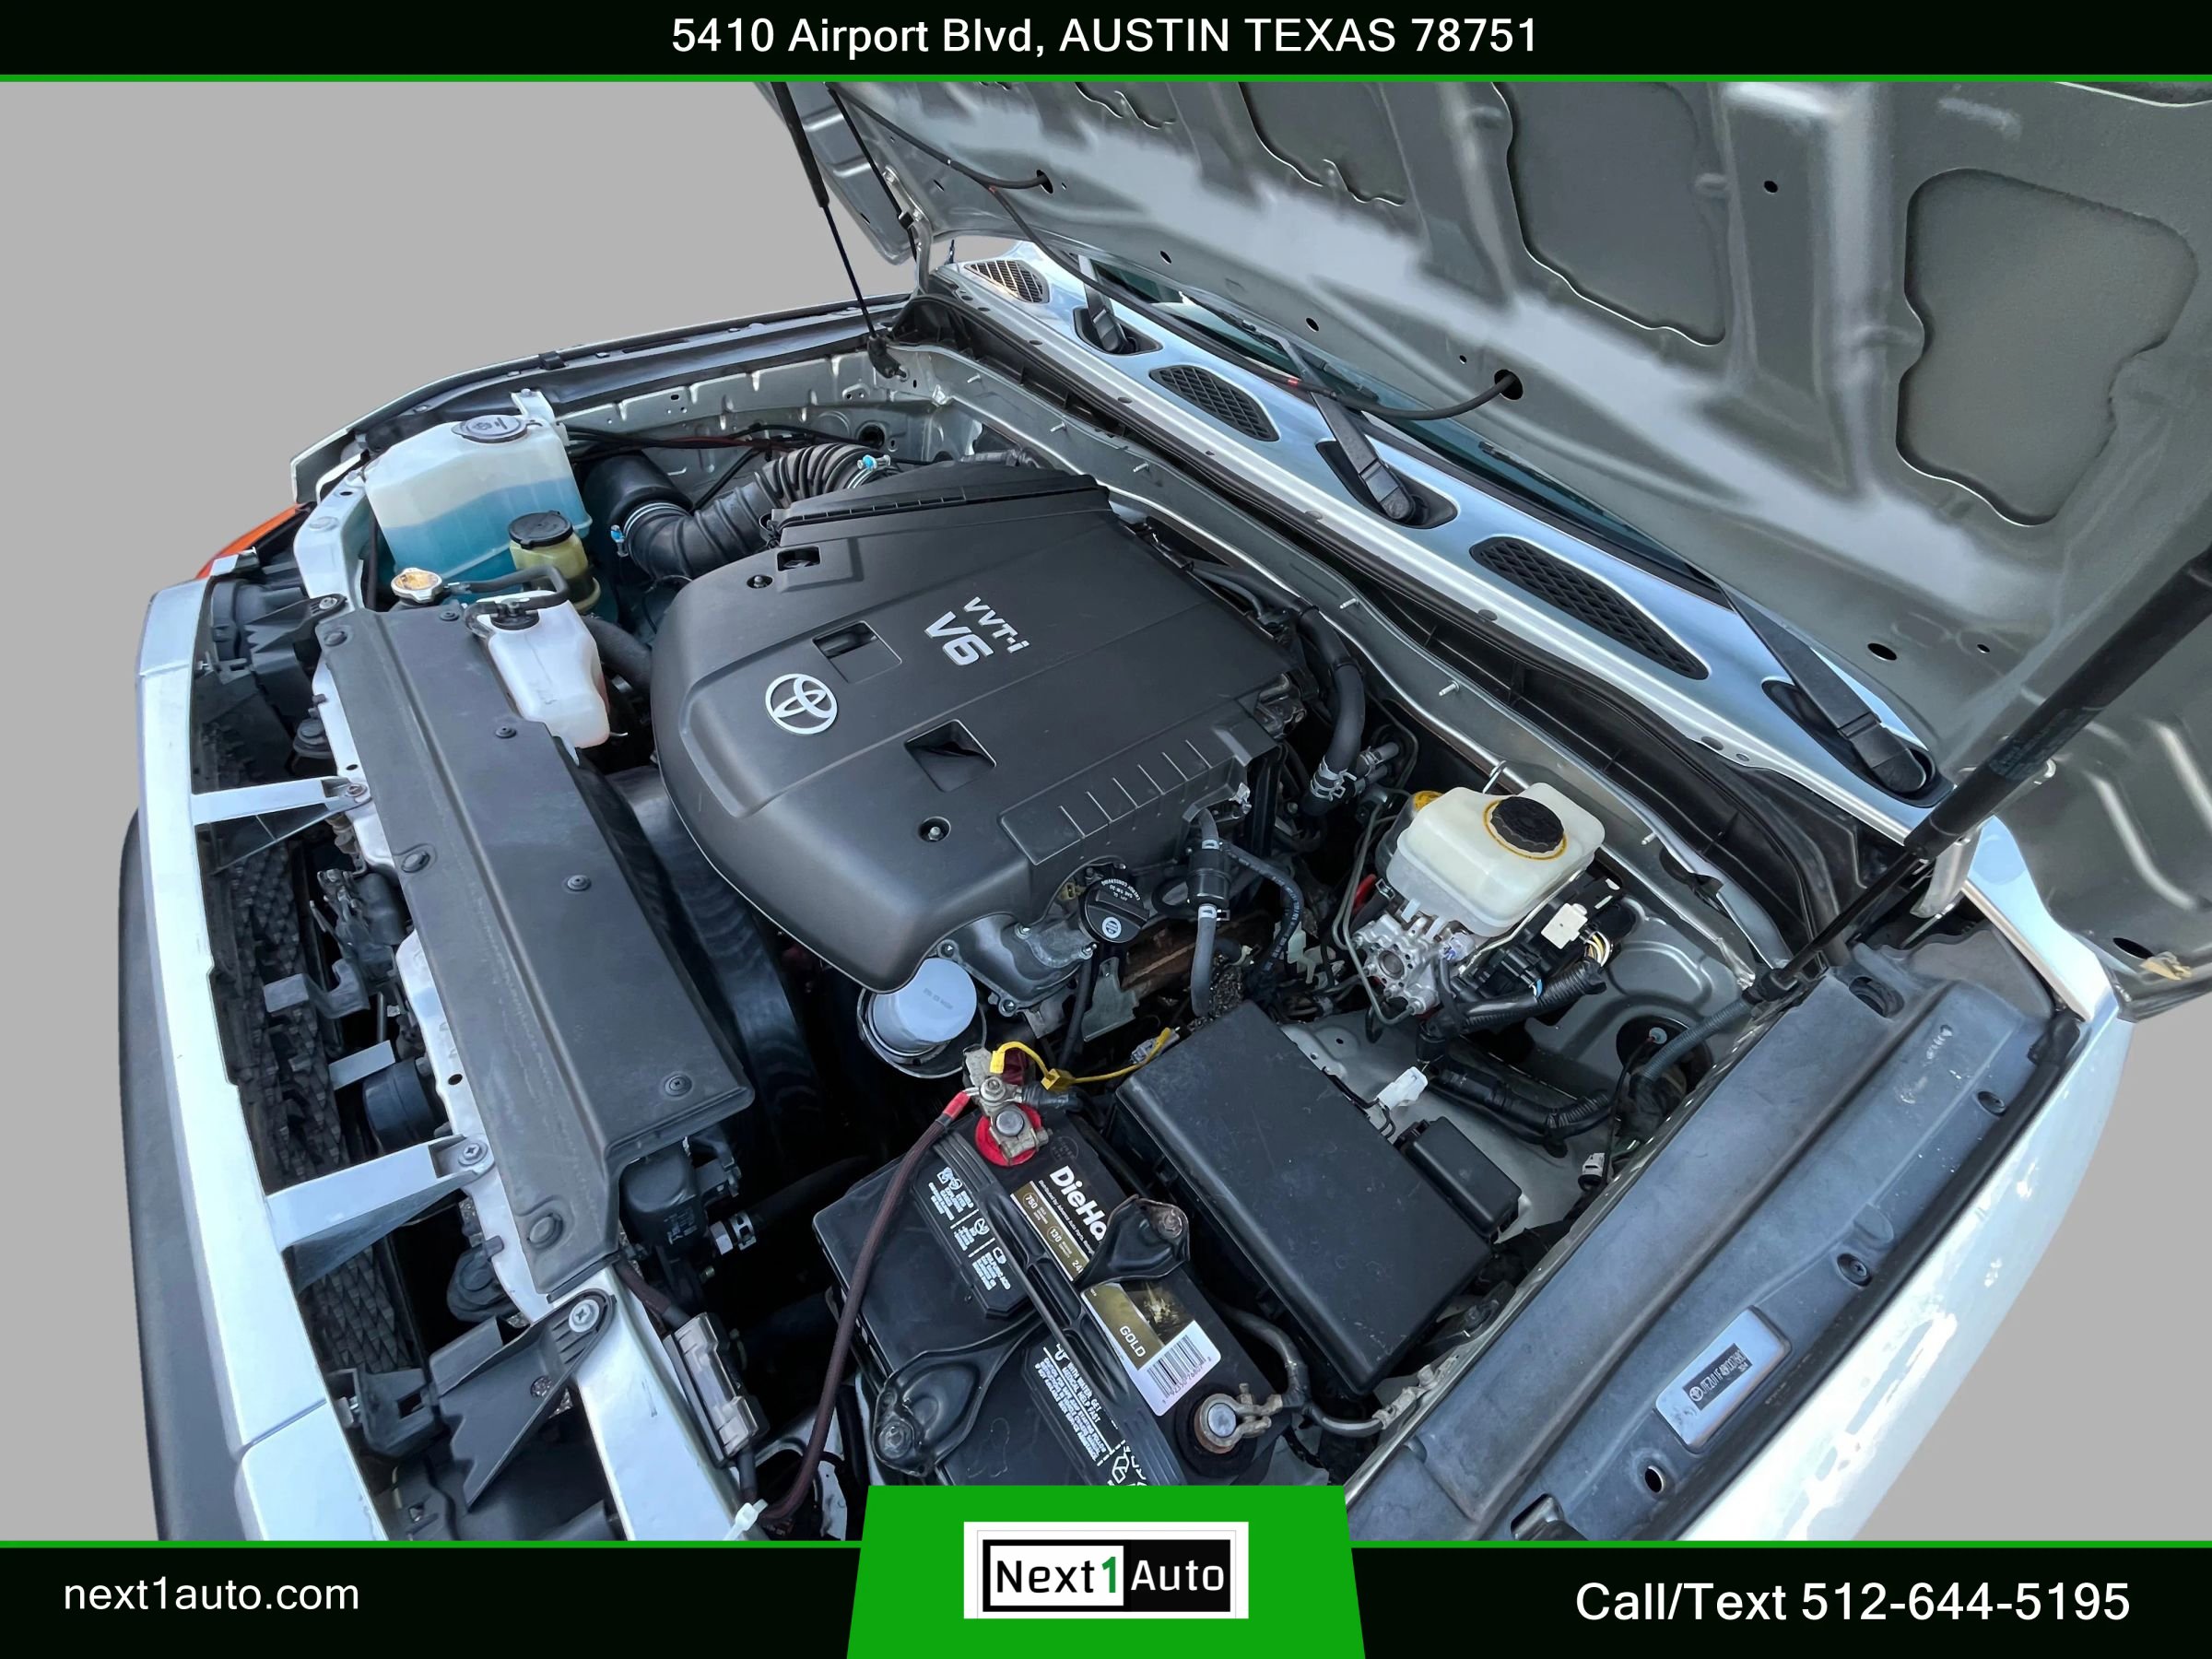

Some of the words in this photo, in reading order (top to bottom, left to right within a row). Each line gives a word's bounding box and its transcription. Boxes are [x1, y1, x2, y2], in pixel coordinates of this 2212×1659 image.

[924, 611, 994, 666] V6
[963, 596, 1030, 653] VVT-i
[1026, 1194, 1038, 1208] 750
[1050, 1165, 1107, 1241] DieHa
[1051, 1229, 1062, 1241] 130
[1120, 1325, 1146, 1357] GOLD
[1062, 1367, 1079, 1392] MEDICAL
[1077, 1391, 1090, 1406] HELP
[1088, 1406, 1100, 1422] FAST
[1091, 1399, 1101, 1411] GET
